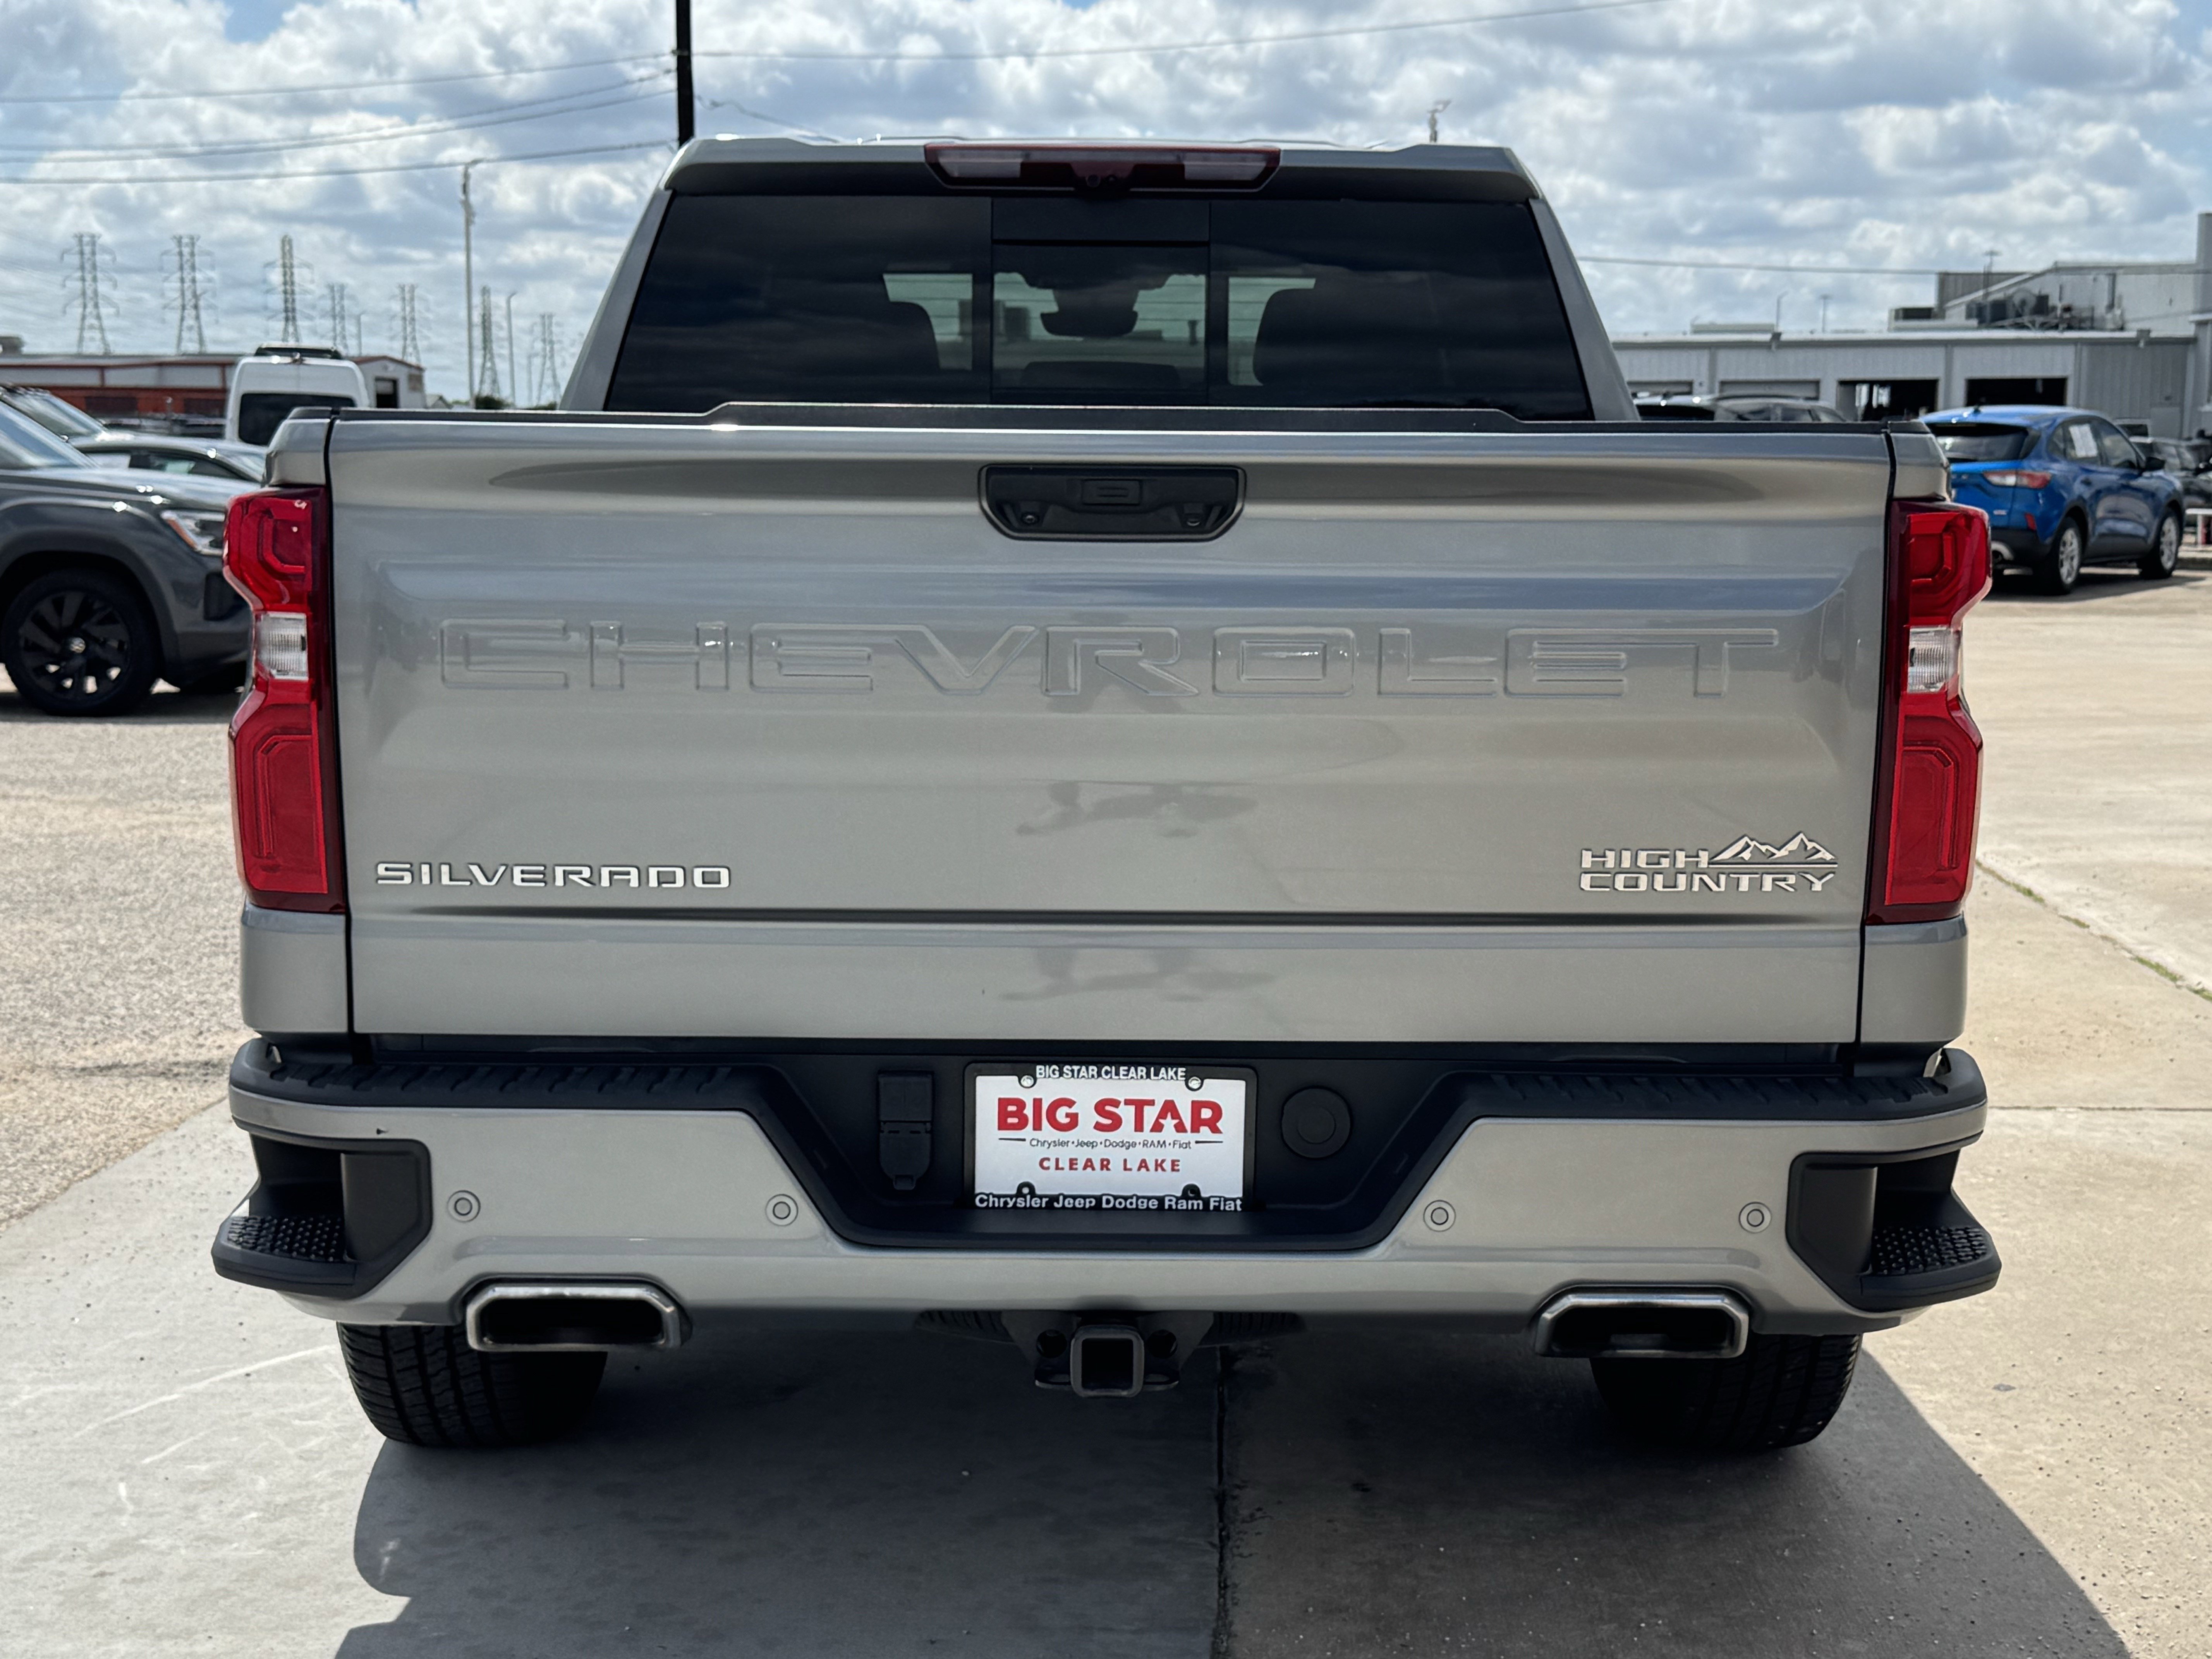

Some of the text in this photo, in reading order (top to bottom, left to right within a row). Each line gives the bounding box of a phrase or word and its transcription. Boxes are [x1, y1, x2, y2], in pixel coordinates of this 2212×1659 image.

[440, 618, 1778, 698] CHEVROLET
[1581, 849, 1709, 868] HIGH
[376, 863, 730, 888] SILVERADO
[1580, 872, 1835, 891] COUNTRY
[1036, 1065, 1186, 1080] BIG STAR CLEAR LAKE
[998, 1097, 1223, 1134] BIG STAR
[1039, 1157, 1181, 1172] CLEAR LAKE
[975, 1194, 1242, 1211] Chrysler Jeep Dodge Ram Fiat
